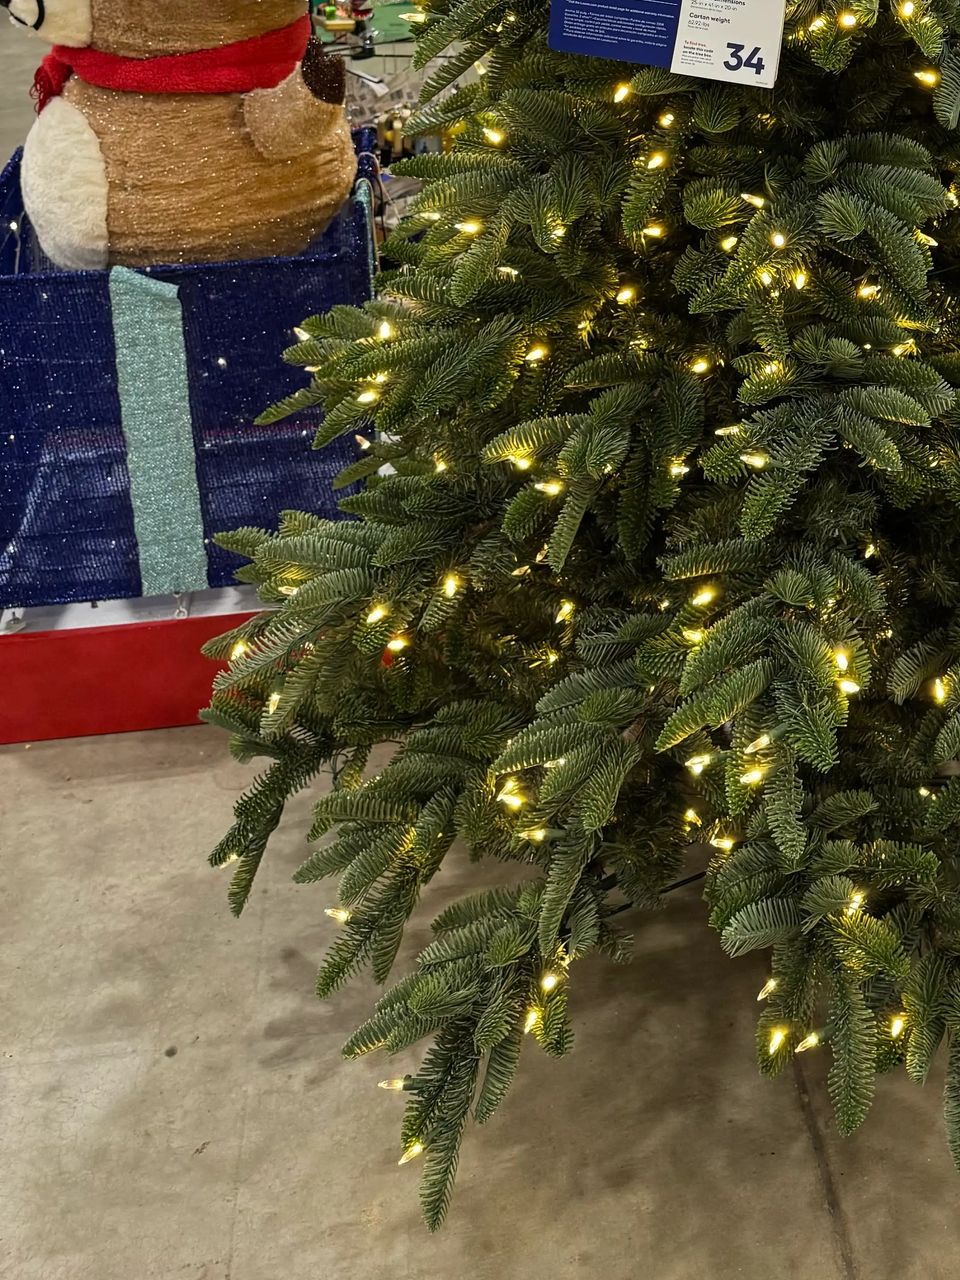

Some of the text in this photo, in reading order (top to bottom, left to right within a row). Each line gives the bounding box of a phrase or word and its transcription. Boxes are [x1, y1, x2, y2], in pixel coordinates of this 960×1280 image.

[689, 12, 731, 25] Carton weight
[722, 42, 766, 75] 34
